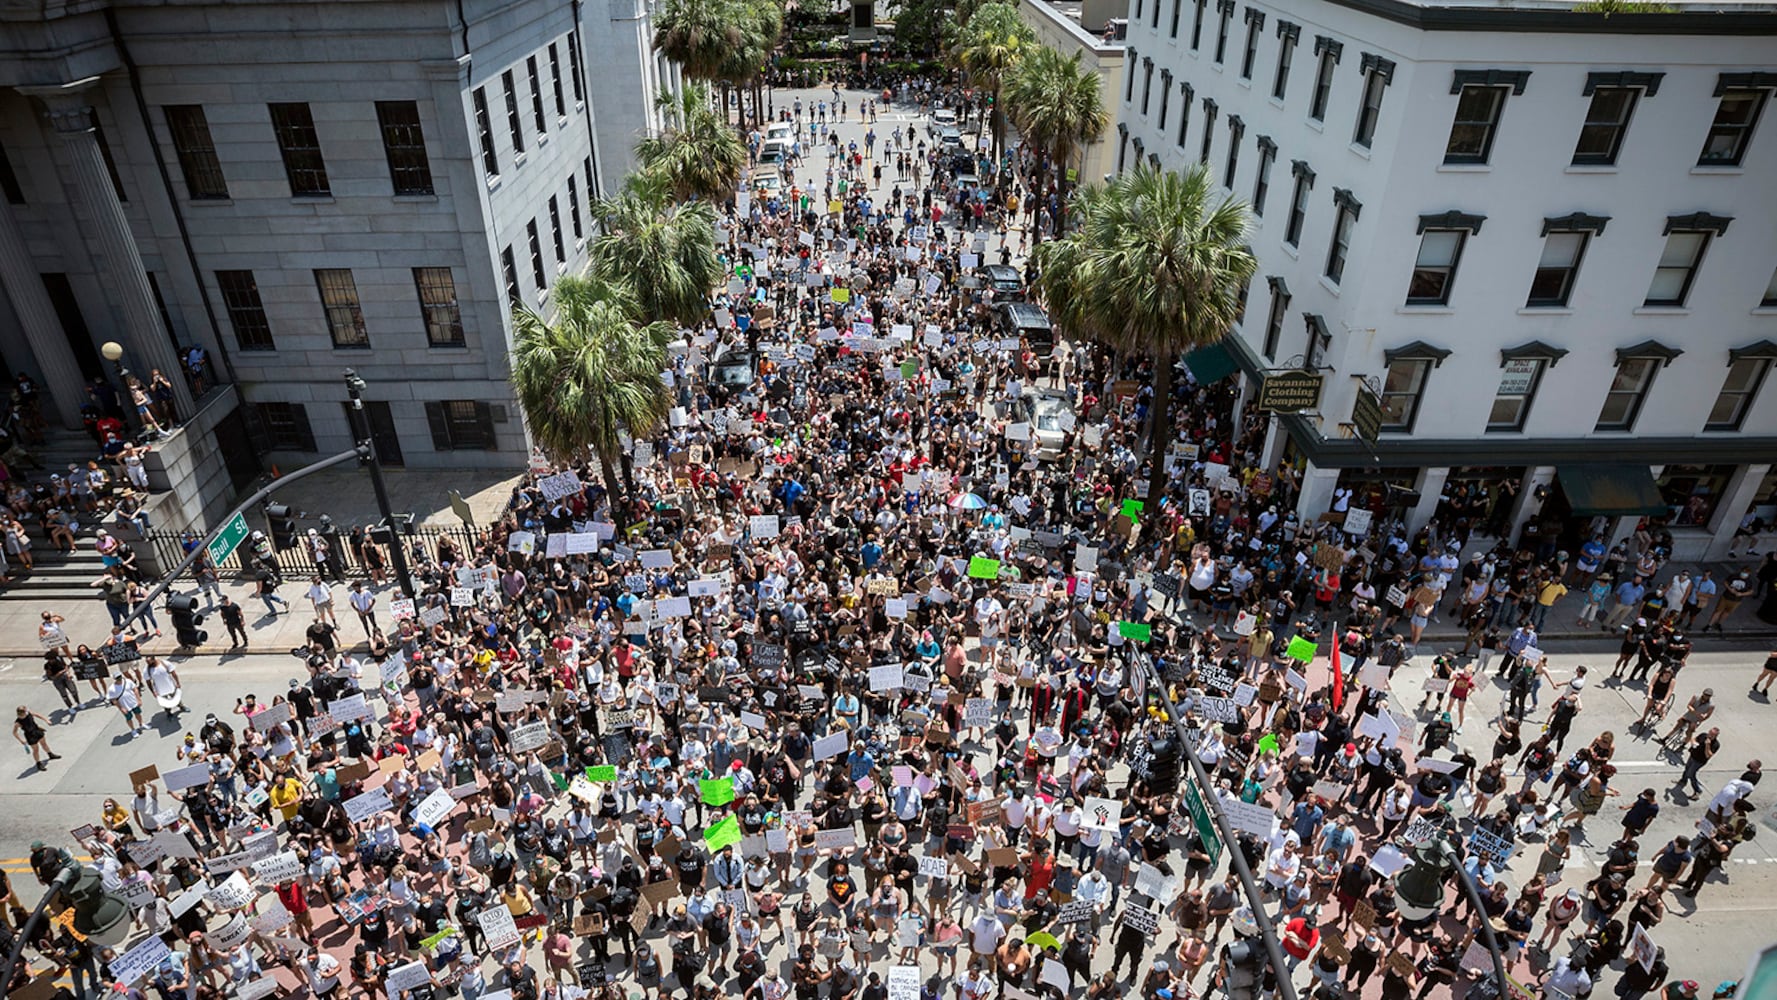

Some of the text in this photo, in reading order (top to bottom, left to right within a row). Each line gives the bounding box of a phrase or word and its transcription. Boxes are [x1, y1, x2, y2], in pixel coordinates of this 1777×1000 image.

[1267, 379, 1320, 387] Savannah
[1269, 388, 1314, 397] Clothing
[1264, 398, 1315, 406] Company
[212, 519, 246, 561] Bull St
[1202, 662, 1228, 674] WHITE
[1200, 669, 1234, 685] SILENCE
[1202, 697, 1234, 712] STOP
[422, 800, 442, 818] BLM
[1186, 784, 1202, 821] Bull
[1476, 838, 1501, 853] WHITE
[1477, 829, 1512, 850] WAKE UP
[920, 859, 946, 876] ACAB
[1060, 907, 1093, 916] WHITE
[1066, 900, 1095, 909] END
[1058, 913, 1093, 924] SILENCE
[1123, 916, 1156, 934] ALIVE
[1124, 911, 1159, 928] WANTED
[489, 931, 518, 947] MURDER
[580, 965, 602, 973] WHITE
